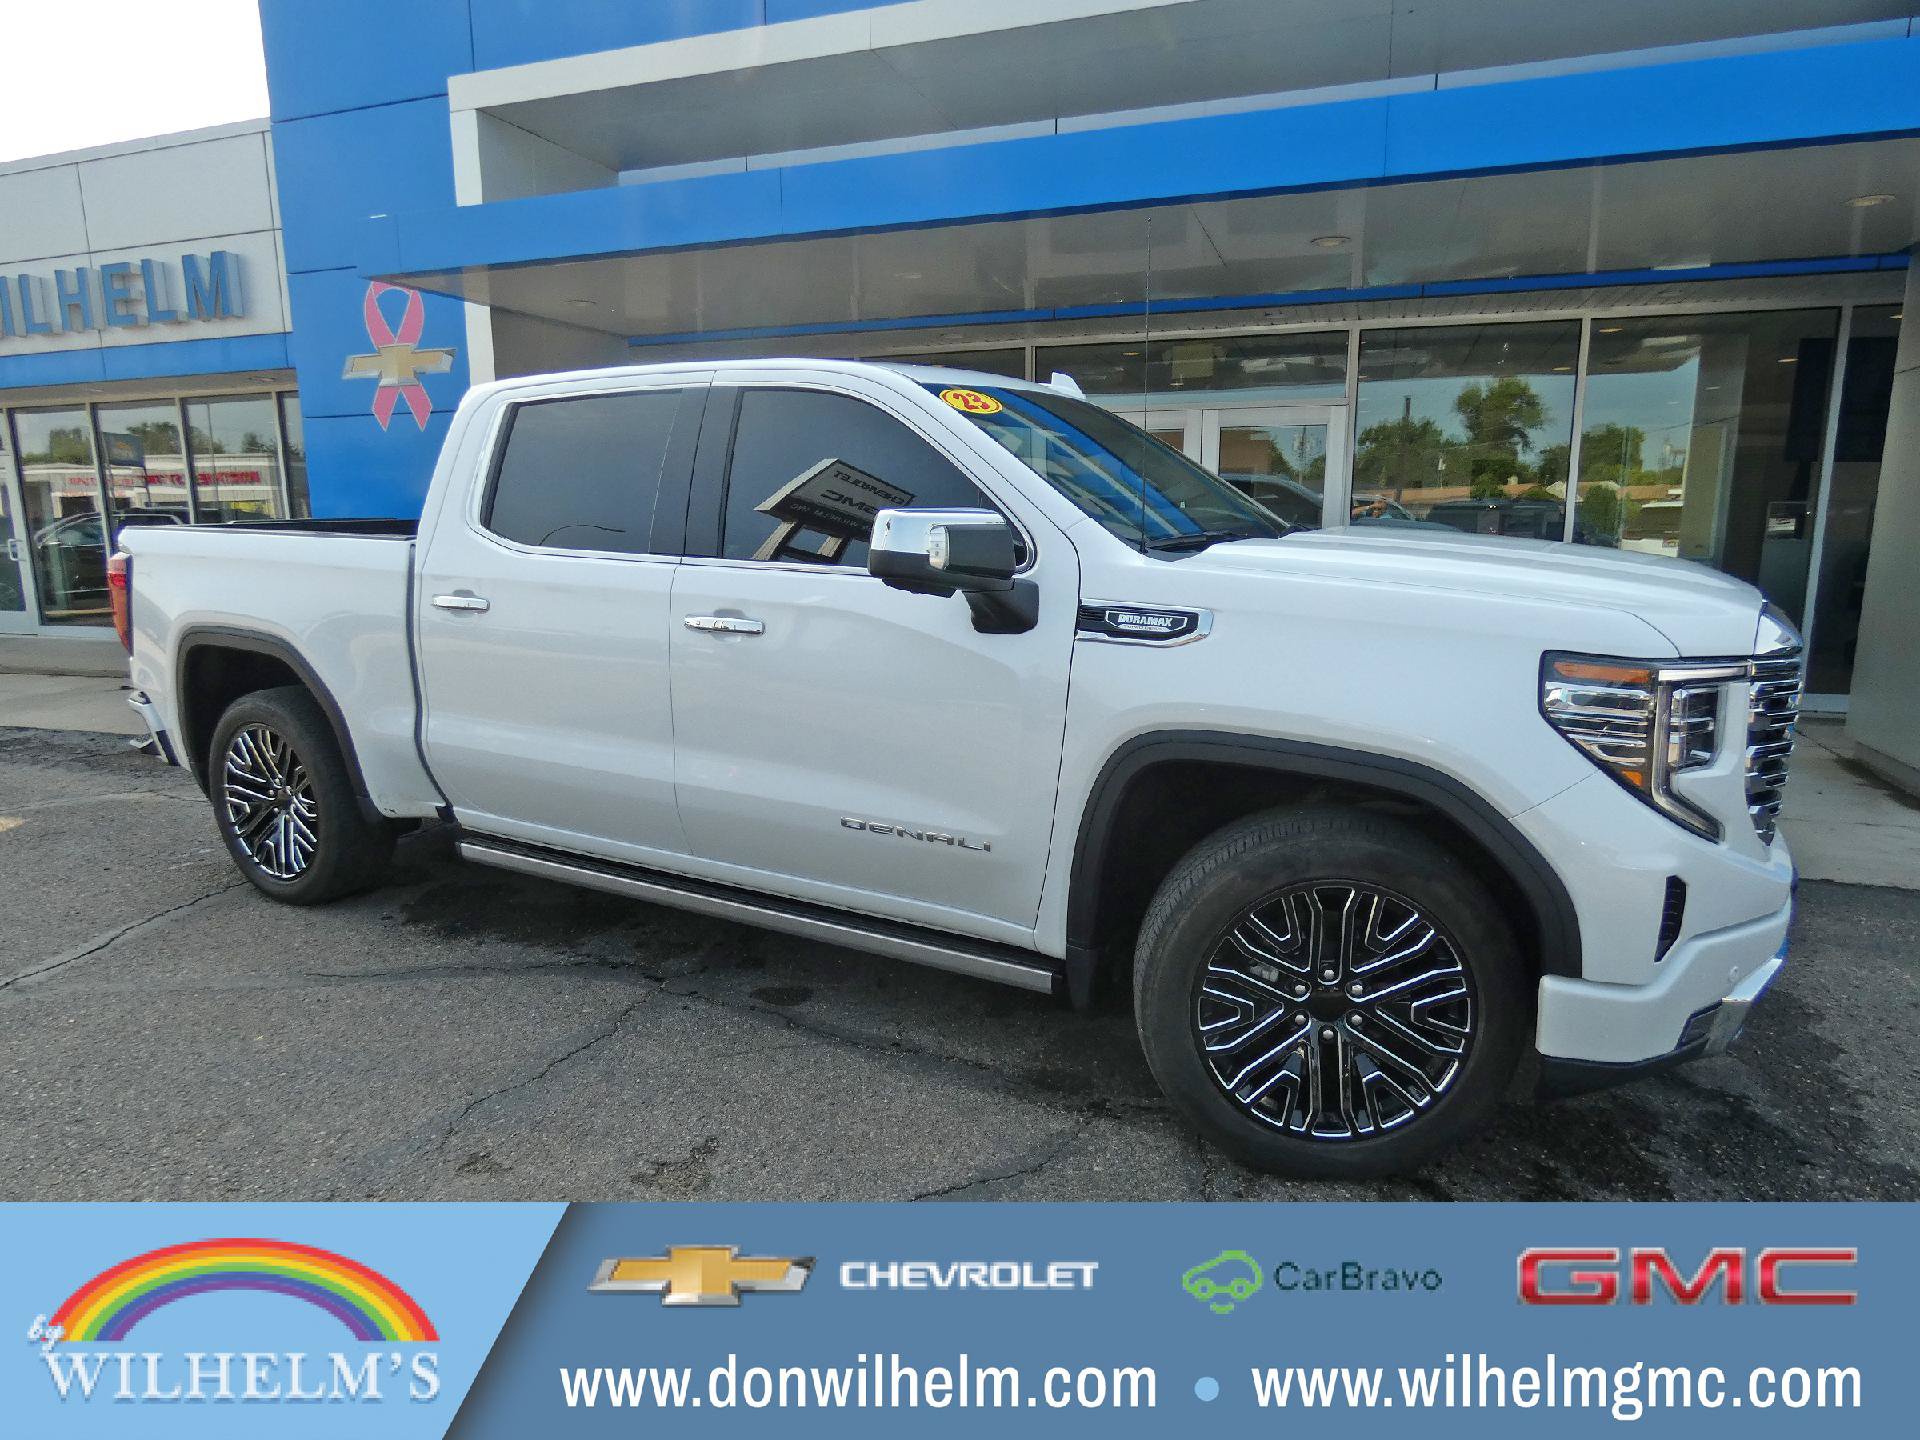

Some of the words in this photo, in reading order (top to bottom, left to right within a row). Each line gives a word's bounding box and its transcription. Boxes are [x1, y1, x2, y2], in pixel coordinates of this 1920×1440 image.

[952, 392, 991, 410] 23
[1117, 613, 1173, 627] DURAMAX
[840, 816, 991, 852] DENALI
